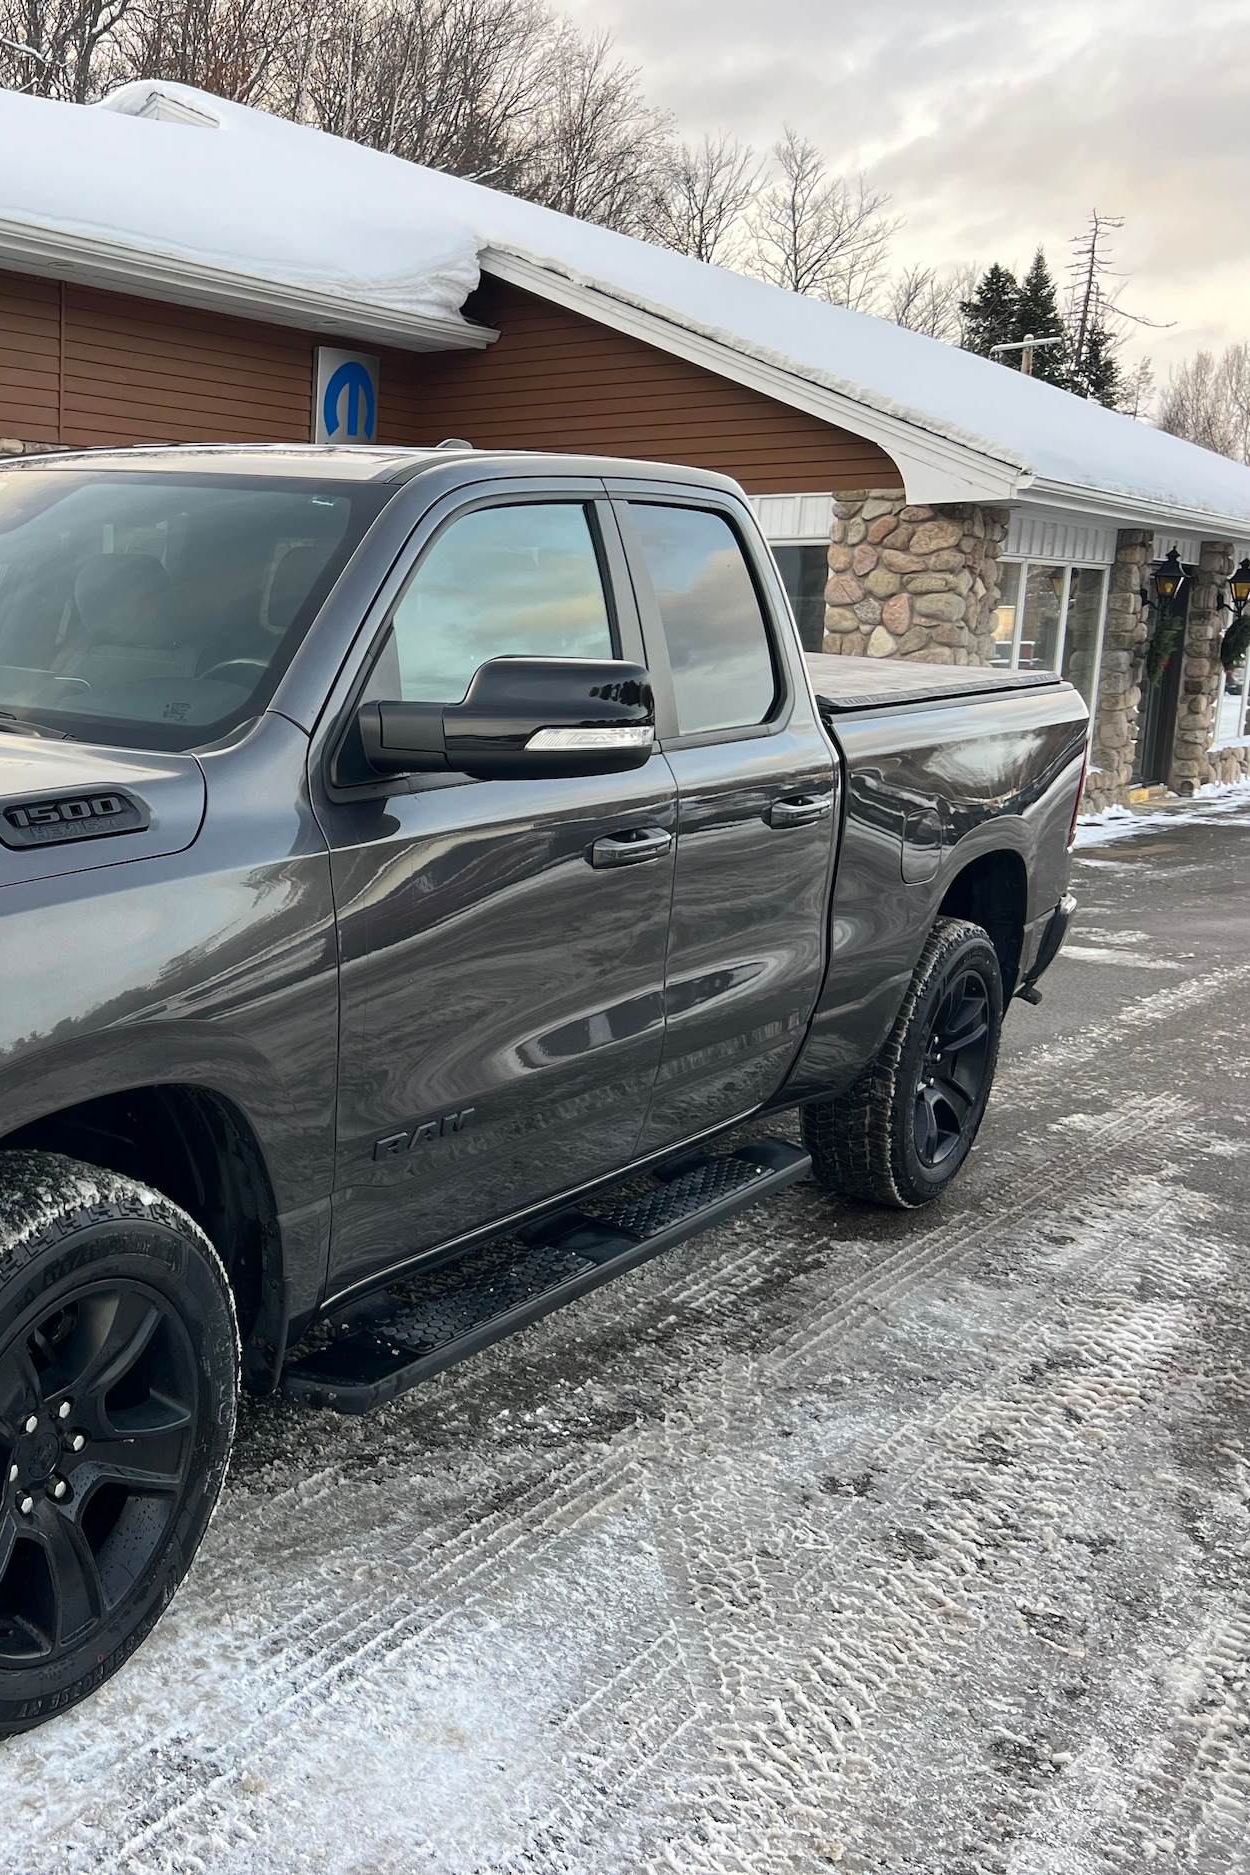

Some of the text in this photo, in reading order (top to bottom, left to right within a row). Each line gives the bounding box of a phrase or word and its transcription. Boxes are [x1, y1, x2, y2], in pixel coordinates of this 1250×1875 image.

[6, 796, 123, 828] 1500
[29, 817, 126, 841] HEMI 5.7L
[371, 1106, 476, 1162] RAM
